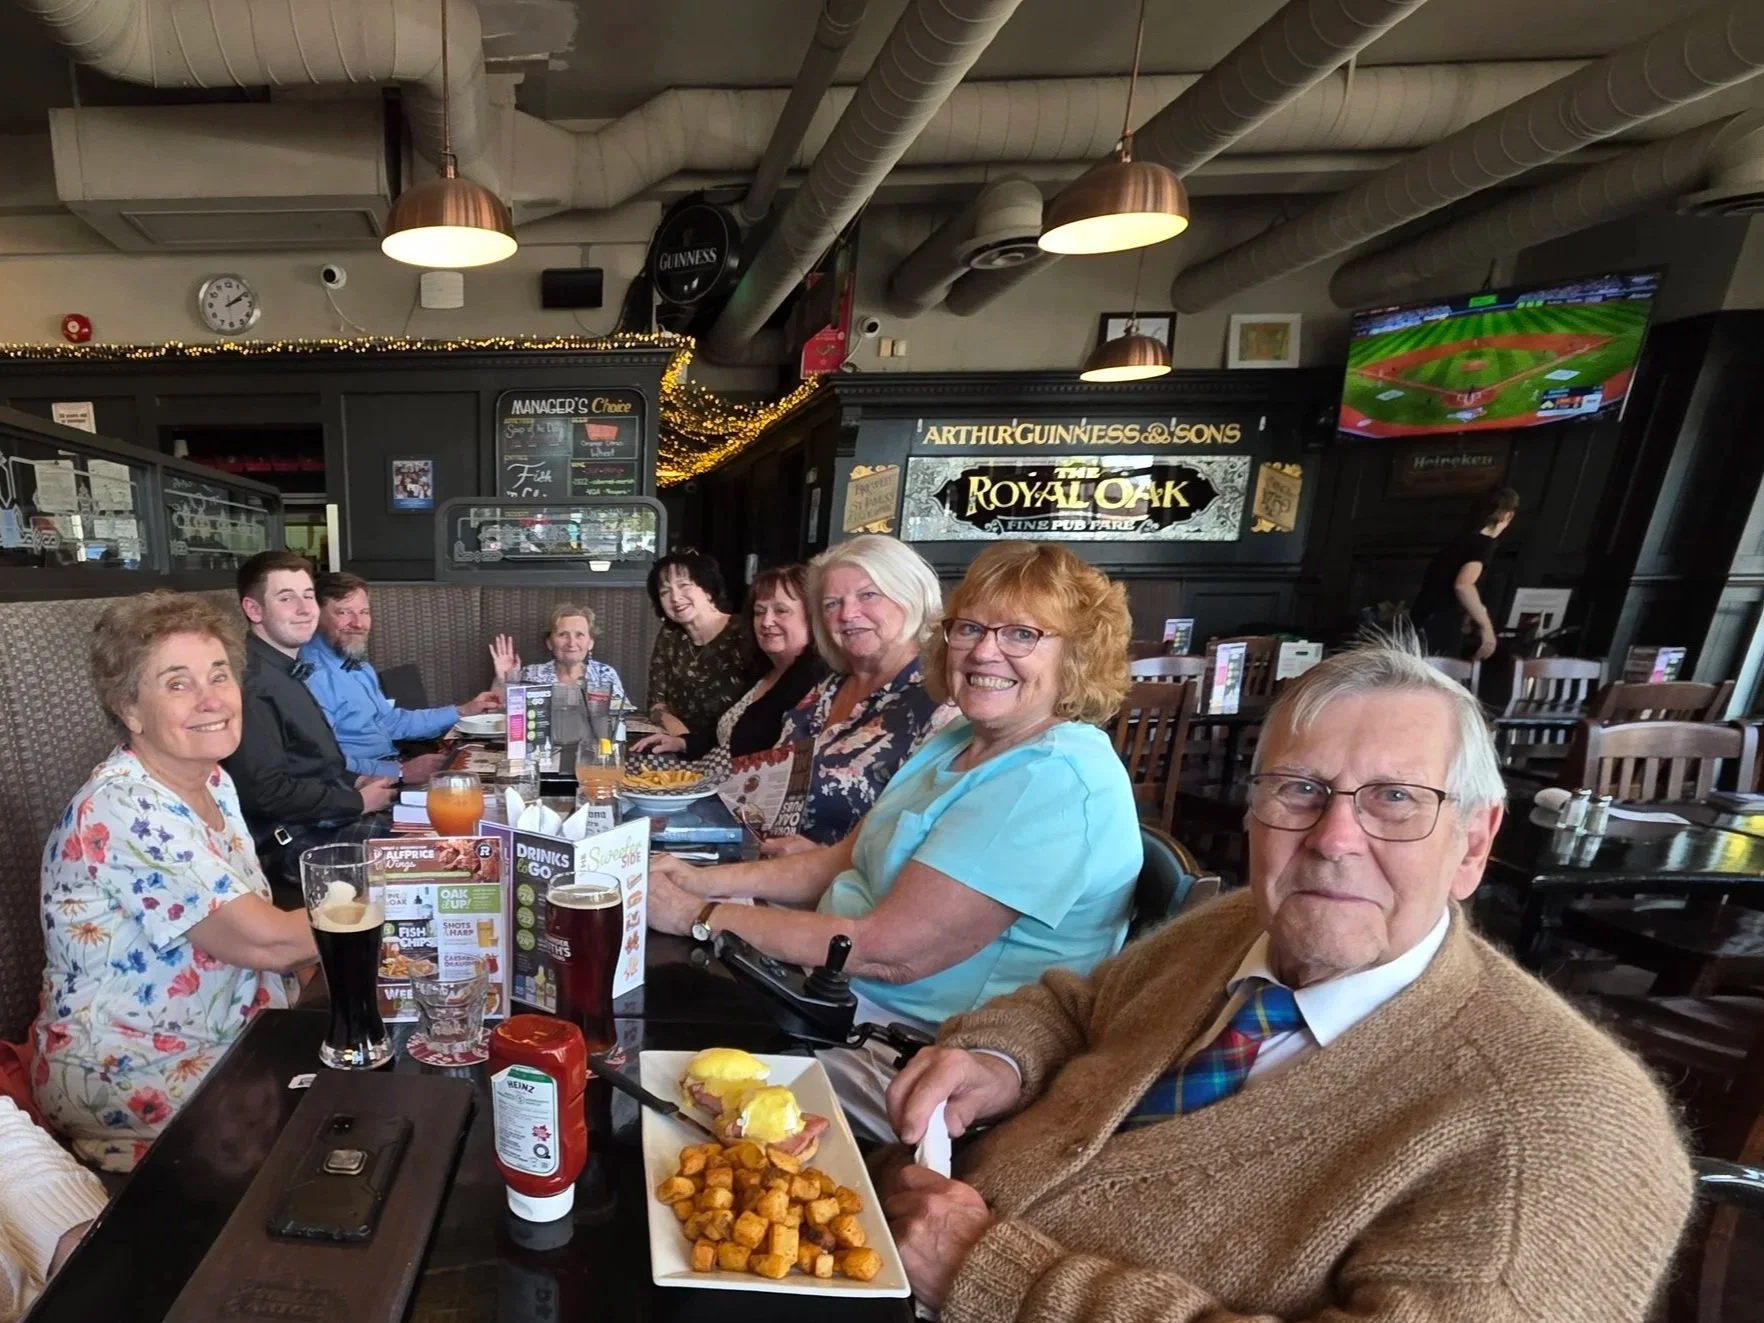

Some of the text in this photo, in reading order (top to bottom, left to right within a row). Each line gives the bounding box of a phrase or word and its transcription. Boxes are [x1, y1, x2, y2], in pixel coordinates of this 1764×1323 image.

[660, 247, 717, 271] GUINNESS
[511, 397, 632, 414] MANAGER'S Choice
[922, 425, 1014, 445] ARTHUR
[1014, 423, 1140, 445] GUINNESS
[1173, 423, 1241, 444] SONS
[507, 461, 551, 489] Fish
[1054, 466, 1100, 479] THE
[965, 475, 1190, 517] ROYAL OAK
[1007, 519, 1136, 531] FINE PUB FARE
[782, 801, 804, 813] PUBS
[587, 811, 607, 819] ona
[776, 812, 800, 826] OAK
[516, 843, 570, 868] DRINKS
[621, 851, 641, 869] SIDE
[528, 861, 552, 880] GO
[440, 888, 468, 900] OAK
[399, 926, 426, 938] FISH
[443, 922, 471, 930] SHOTS
[506, 1080, 536, 1094] HEINZ
